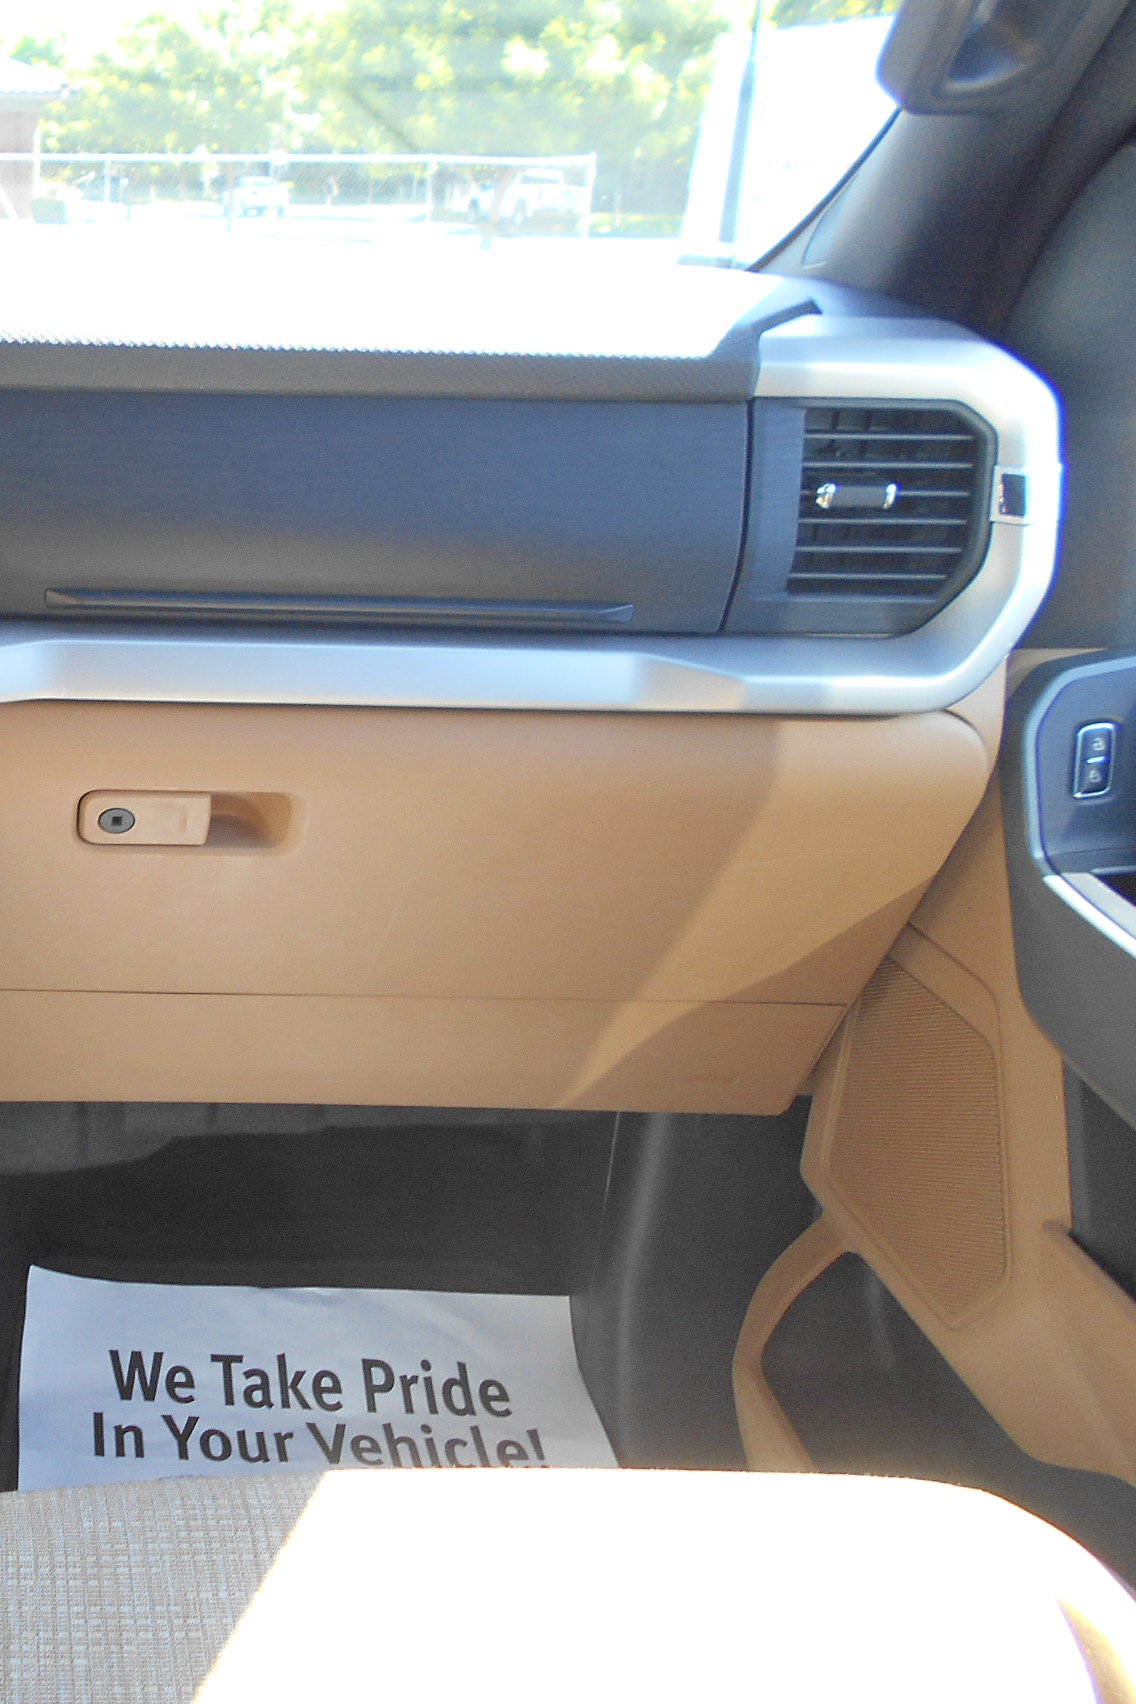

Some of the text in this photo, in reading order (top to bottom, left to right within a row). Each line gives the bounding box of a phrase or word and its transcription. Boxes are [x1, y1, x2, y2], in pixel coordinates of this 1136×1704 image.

[109, 1349, 511, 1417] We Take Pride
[93, 1412, 549, 1468] In Your Vehicle!
